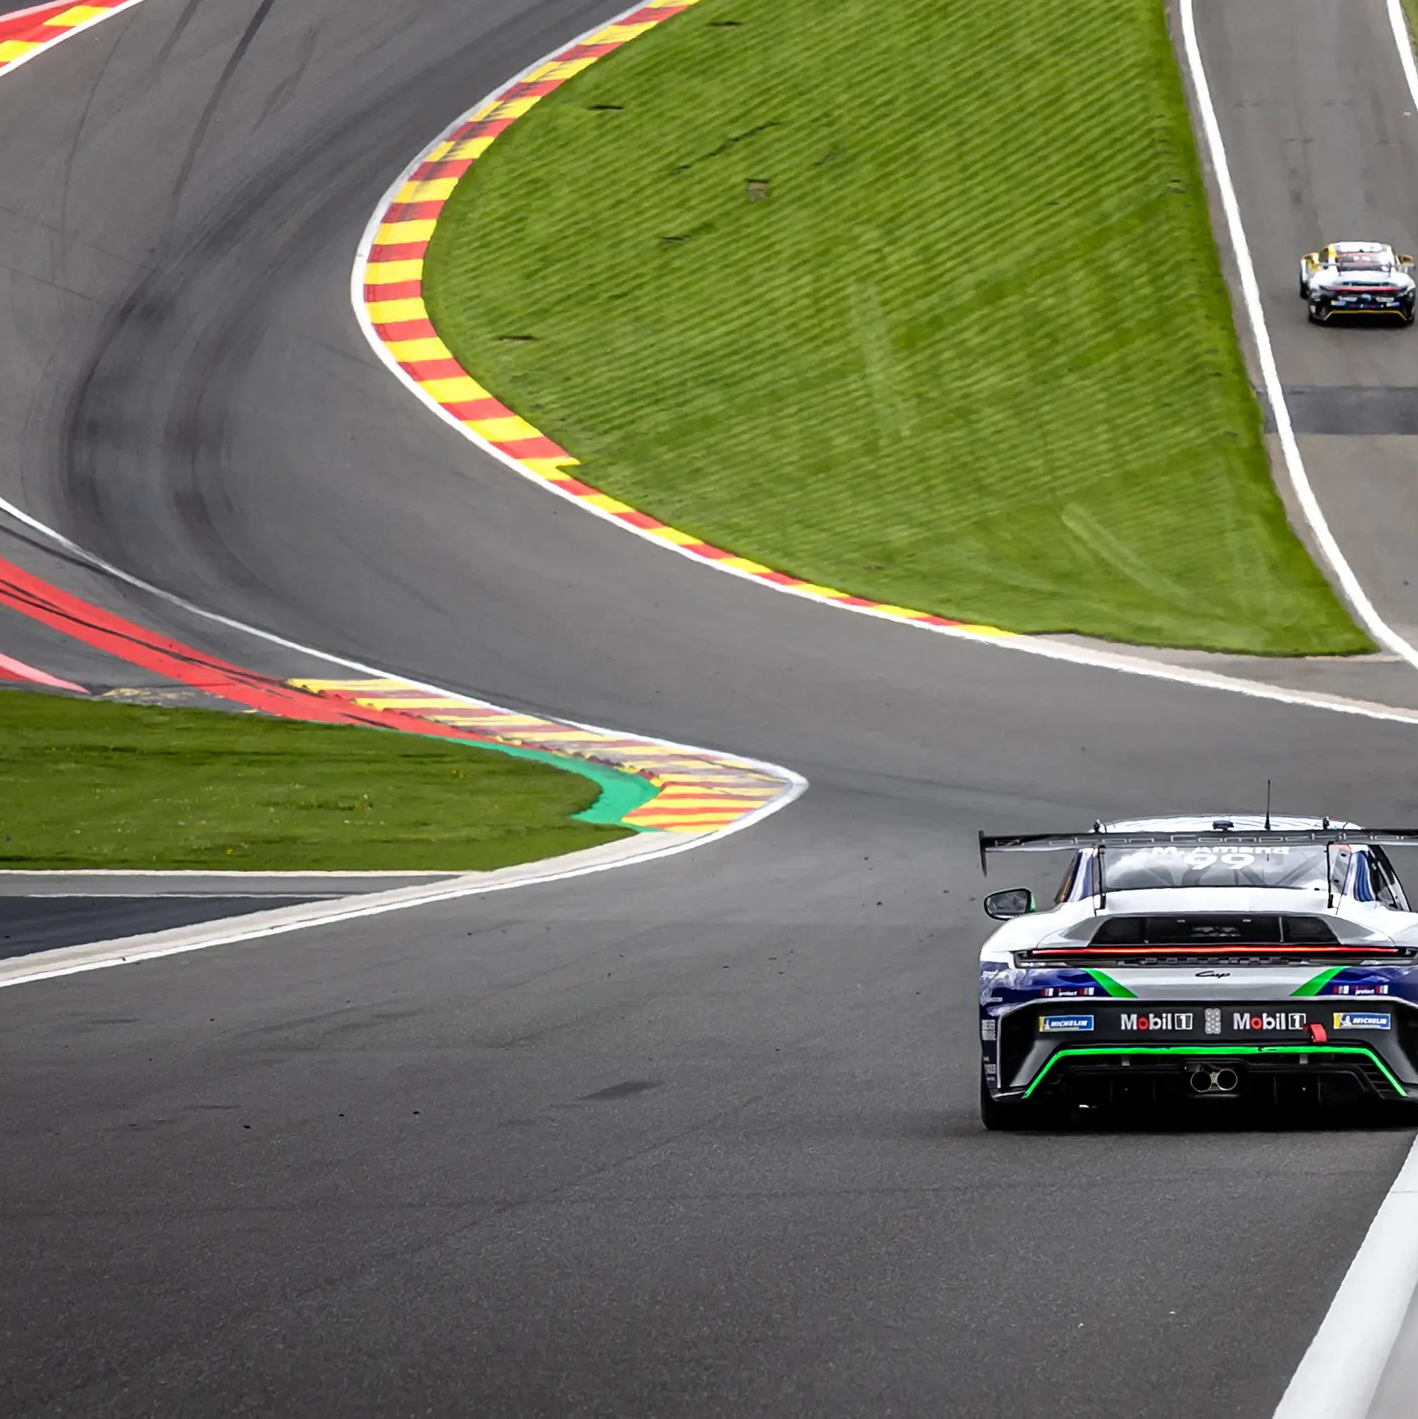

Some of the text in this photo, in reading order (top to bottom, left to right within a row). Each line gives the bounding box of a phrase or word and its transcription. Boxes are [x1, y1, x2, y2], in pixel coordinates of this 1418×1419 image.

[1183, 853, 1256, 870] 99
[1195, 969, 1231, 979] Cup
[1050, 1019, 1089, 1028] MICHELIN
[1120, 1012, 1172, 1030] Mobil
[1233, 1012, 1286, 1030] Mobil
[1352, 1017, 1388, 1025] MICHELIN
